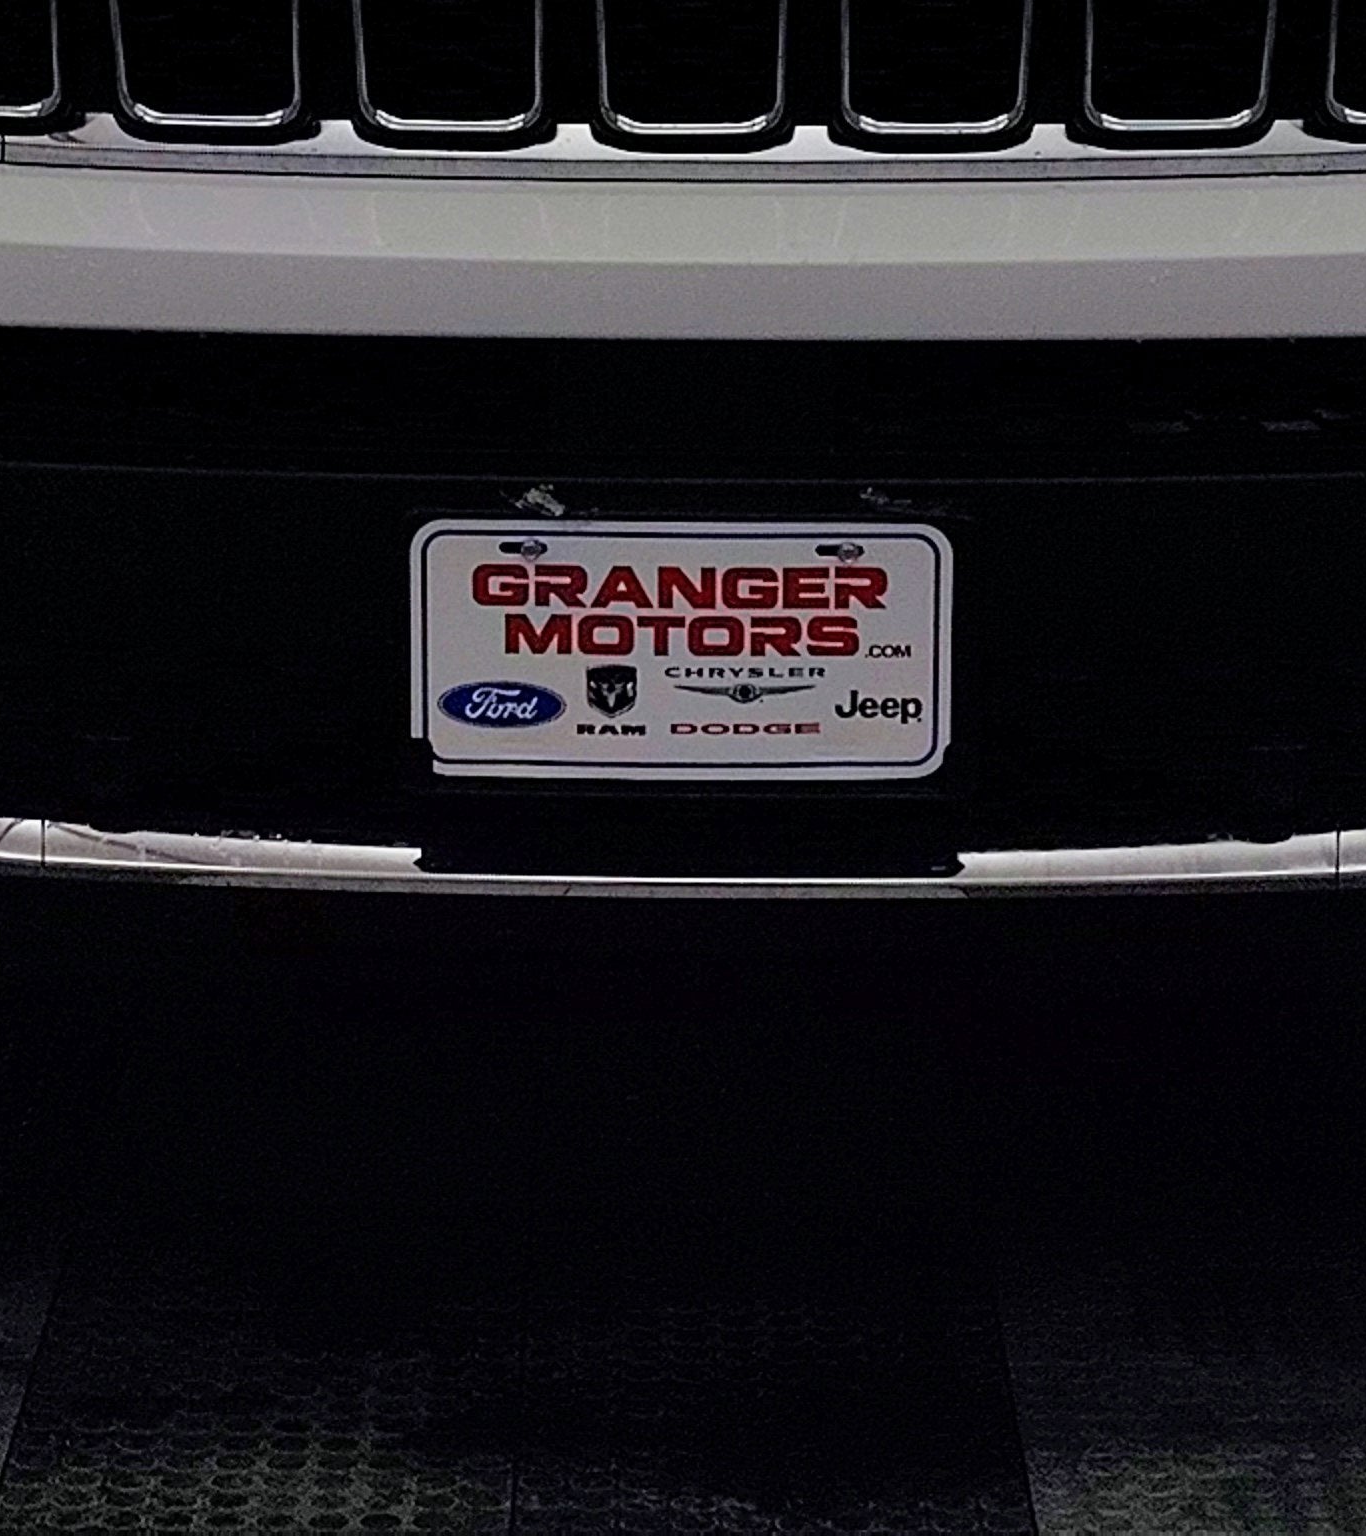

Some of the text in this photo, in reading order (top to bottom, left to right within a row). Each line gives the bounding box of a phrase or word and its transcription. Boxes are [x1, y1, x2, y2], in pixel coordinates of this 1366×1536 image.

[471, 563, 888, 610] GRANGER
[504, 614, 860, 657] MOTORS
[664, 666, 826, 679] CHRYSLER
[464, 686, 539, 721] Ford
[834, 689, 922, 724] Jeep
[576, 723, 647, 736] RAM
[670, 722, 822, 735] DODGE
